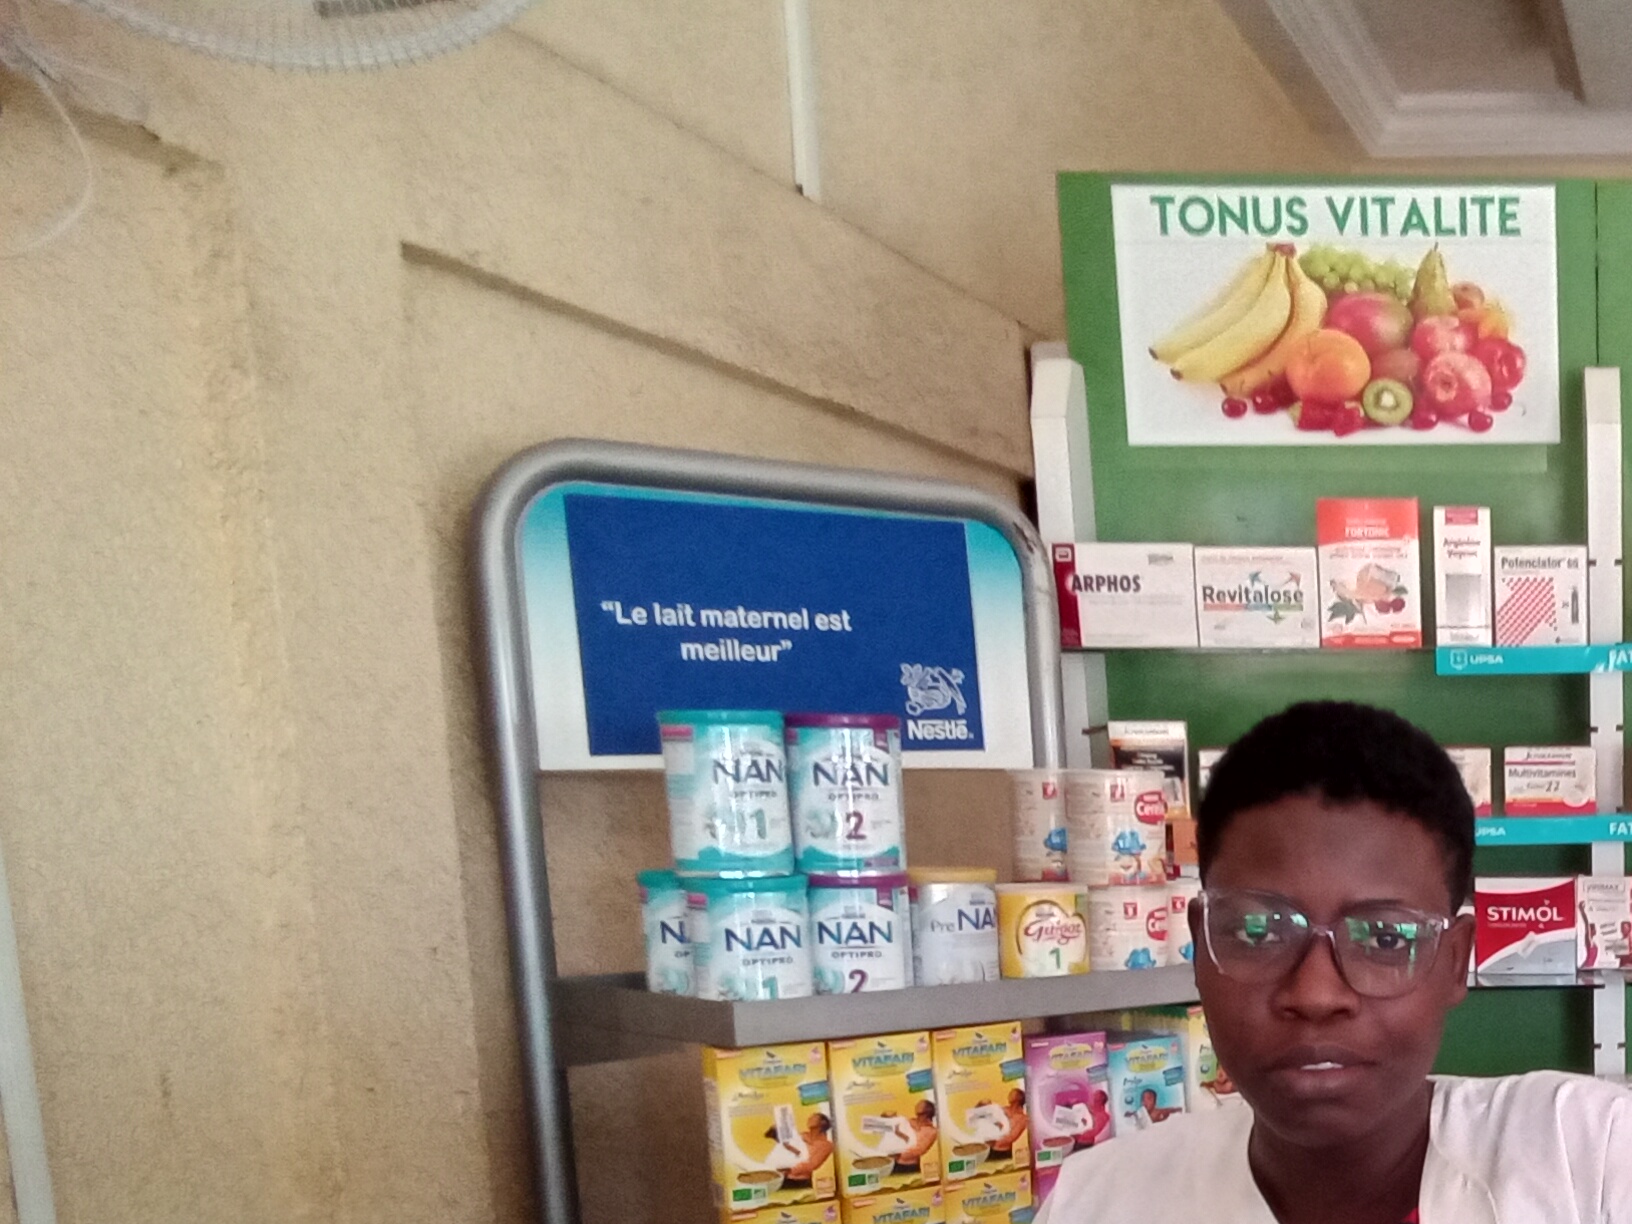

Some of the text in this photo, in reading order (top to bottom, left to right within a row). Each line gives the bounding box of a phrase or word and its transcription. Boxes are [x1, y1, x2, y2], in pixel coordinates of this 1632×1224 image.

[1152, 195, 1521, 237] TONUS VITALITE
[1071, 574, 1142, 593] ARPHOS
[1202, 583, 1304, 604] Revitalose
[653, 603, 695, 627] lait
[700, 606, 809, 631] maternel
[815, 610, 852, 632] est
[1470, 655, 1503, 664] UPSA
[714, 759, 784, 784] NAN
[813, 762, 891, 787] NAN
[846, 810, 867, 840] 2
[931, 908, 996, 933] Pre NA
[1487, 904, 1563, 924] STIMOL
[725, 925, 802, 952] NAN
[817, 920, 894, 945] NAN
[832, 951, 882, 959] OPTIPRO
[1048, 947, 1061, 969] 1
